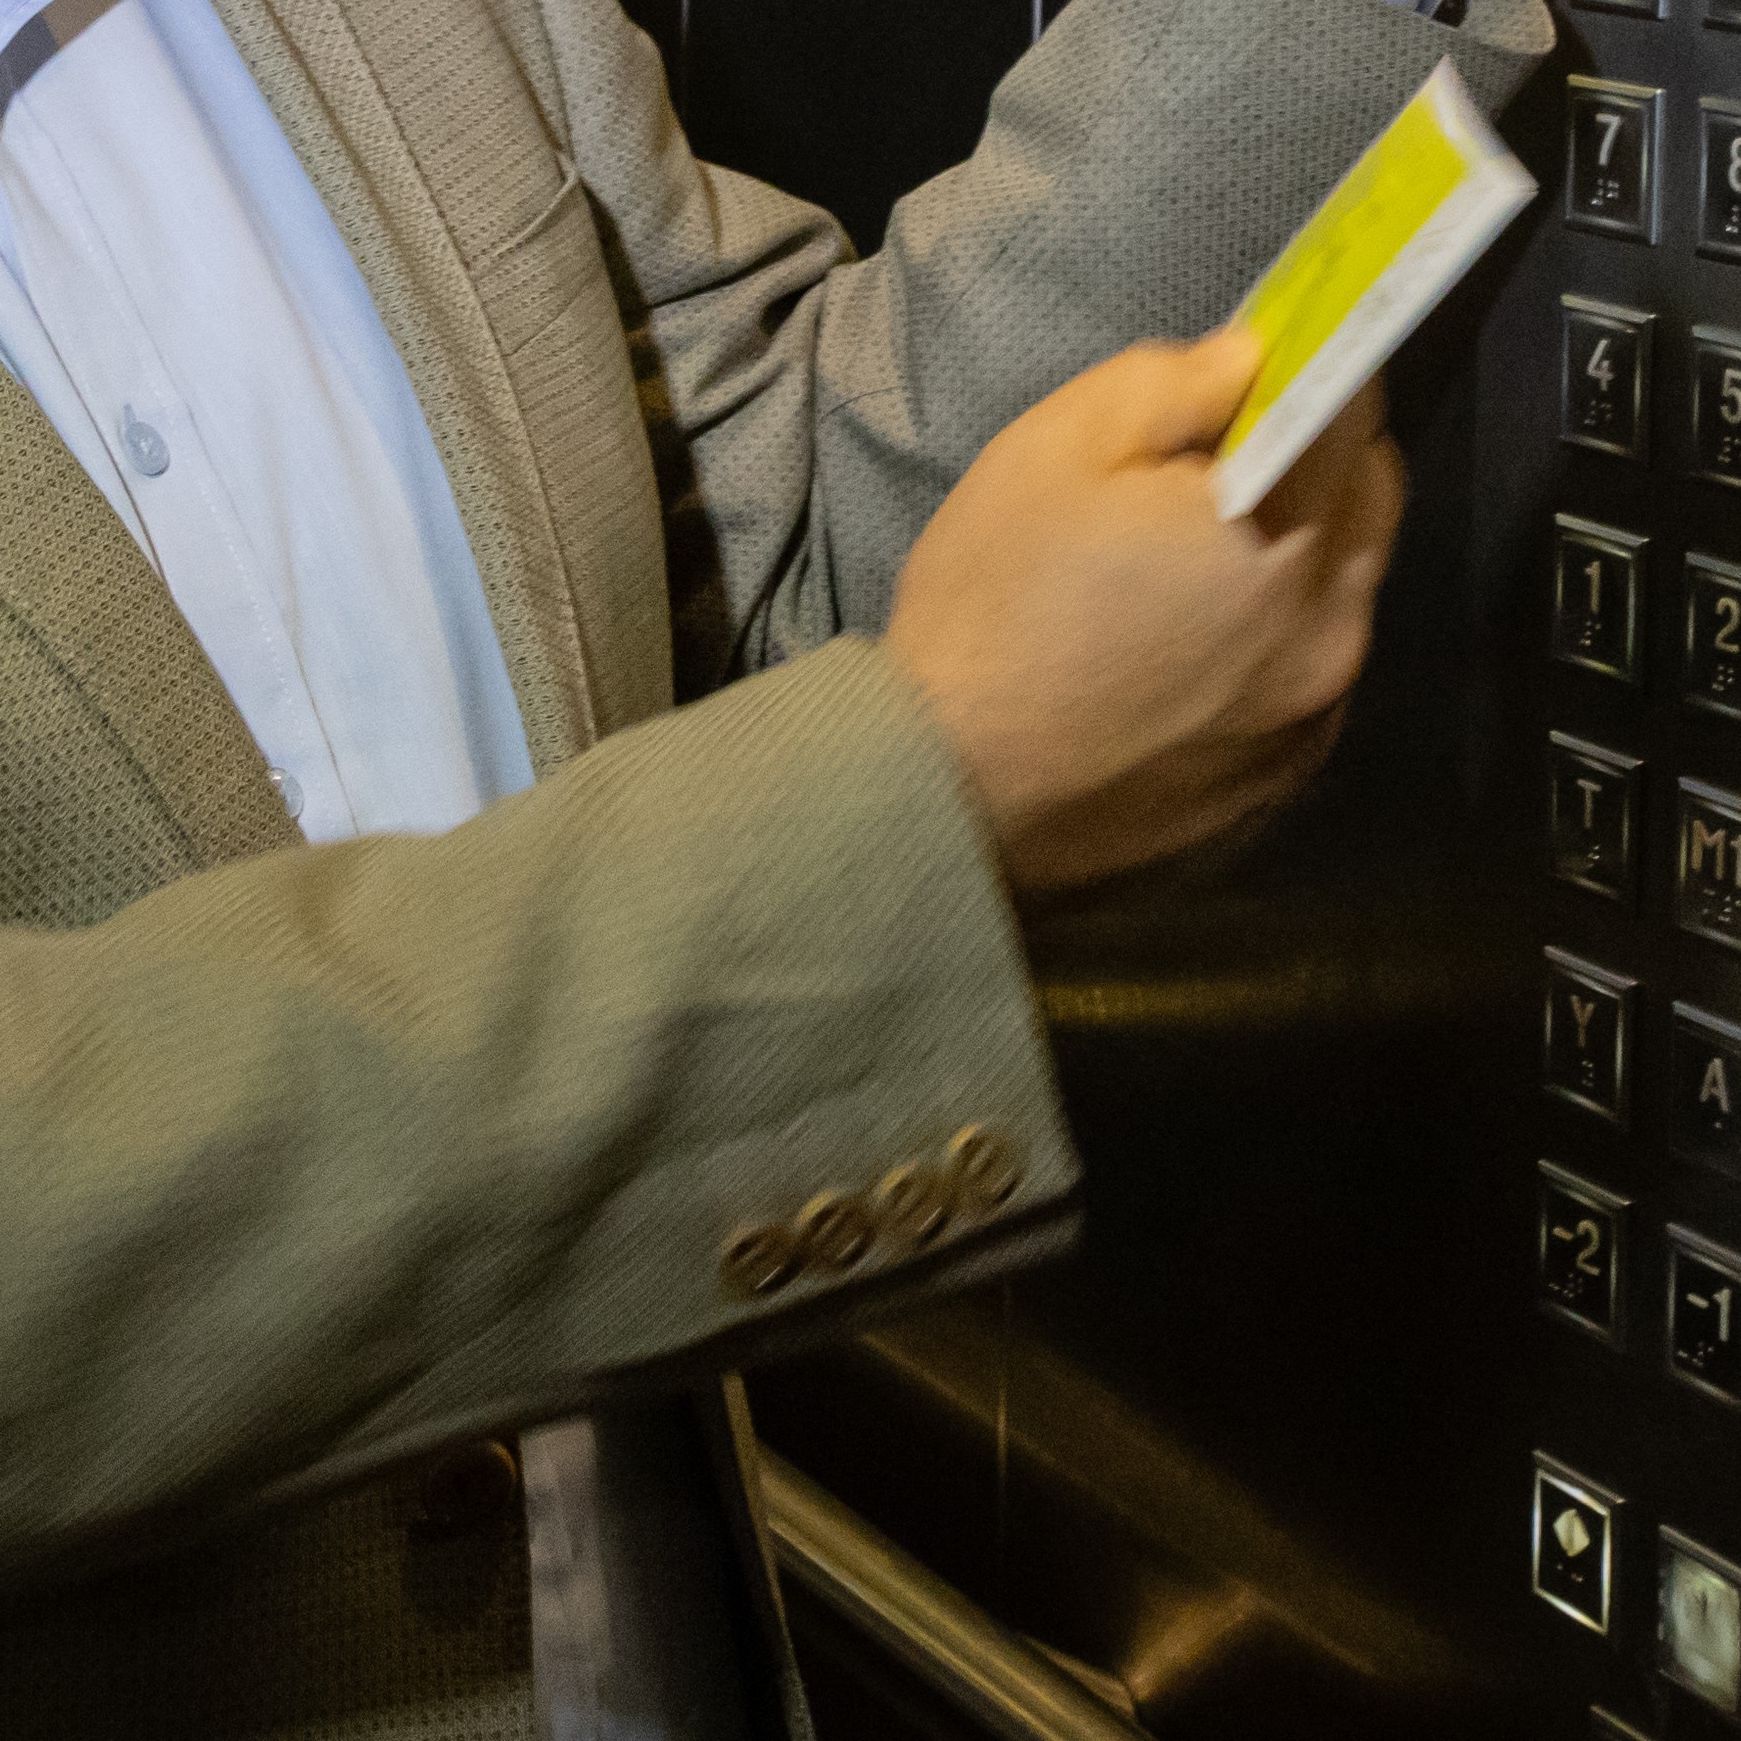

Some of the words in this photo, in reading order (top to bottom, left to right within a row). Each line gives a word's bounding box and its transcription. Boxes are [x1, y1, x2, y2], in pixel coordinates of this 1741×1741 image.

[1595, 113, 1623, 166] 7
[1587, 339, 1614, 392] 4
[1585, 561, 1601, 615] 1
[1715, 597, 1741, 653] 2
[1577, 779, 1602, 829] T
[1570, 995, 1595, 1047] Y
[1700, 1058, 1731, 1113] A
[1553, 1219, 1601, 1275] -2
[1687, 1287, 1732, 1342] -1
